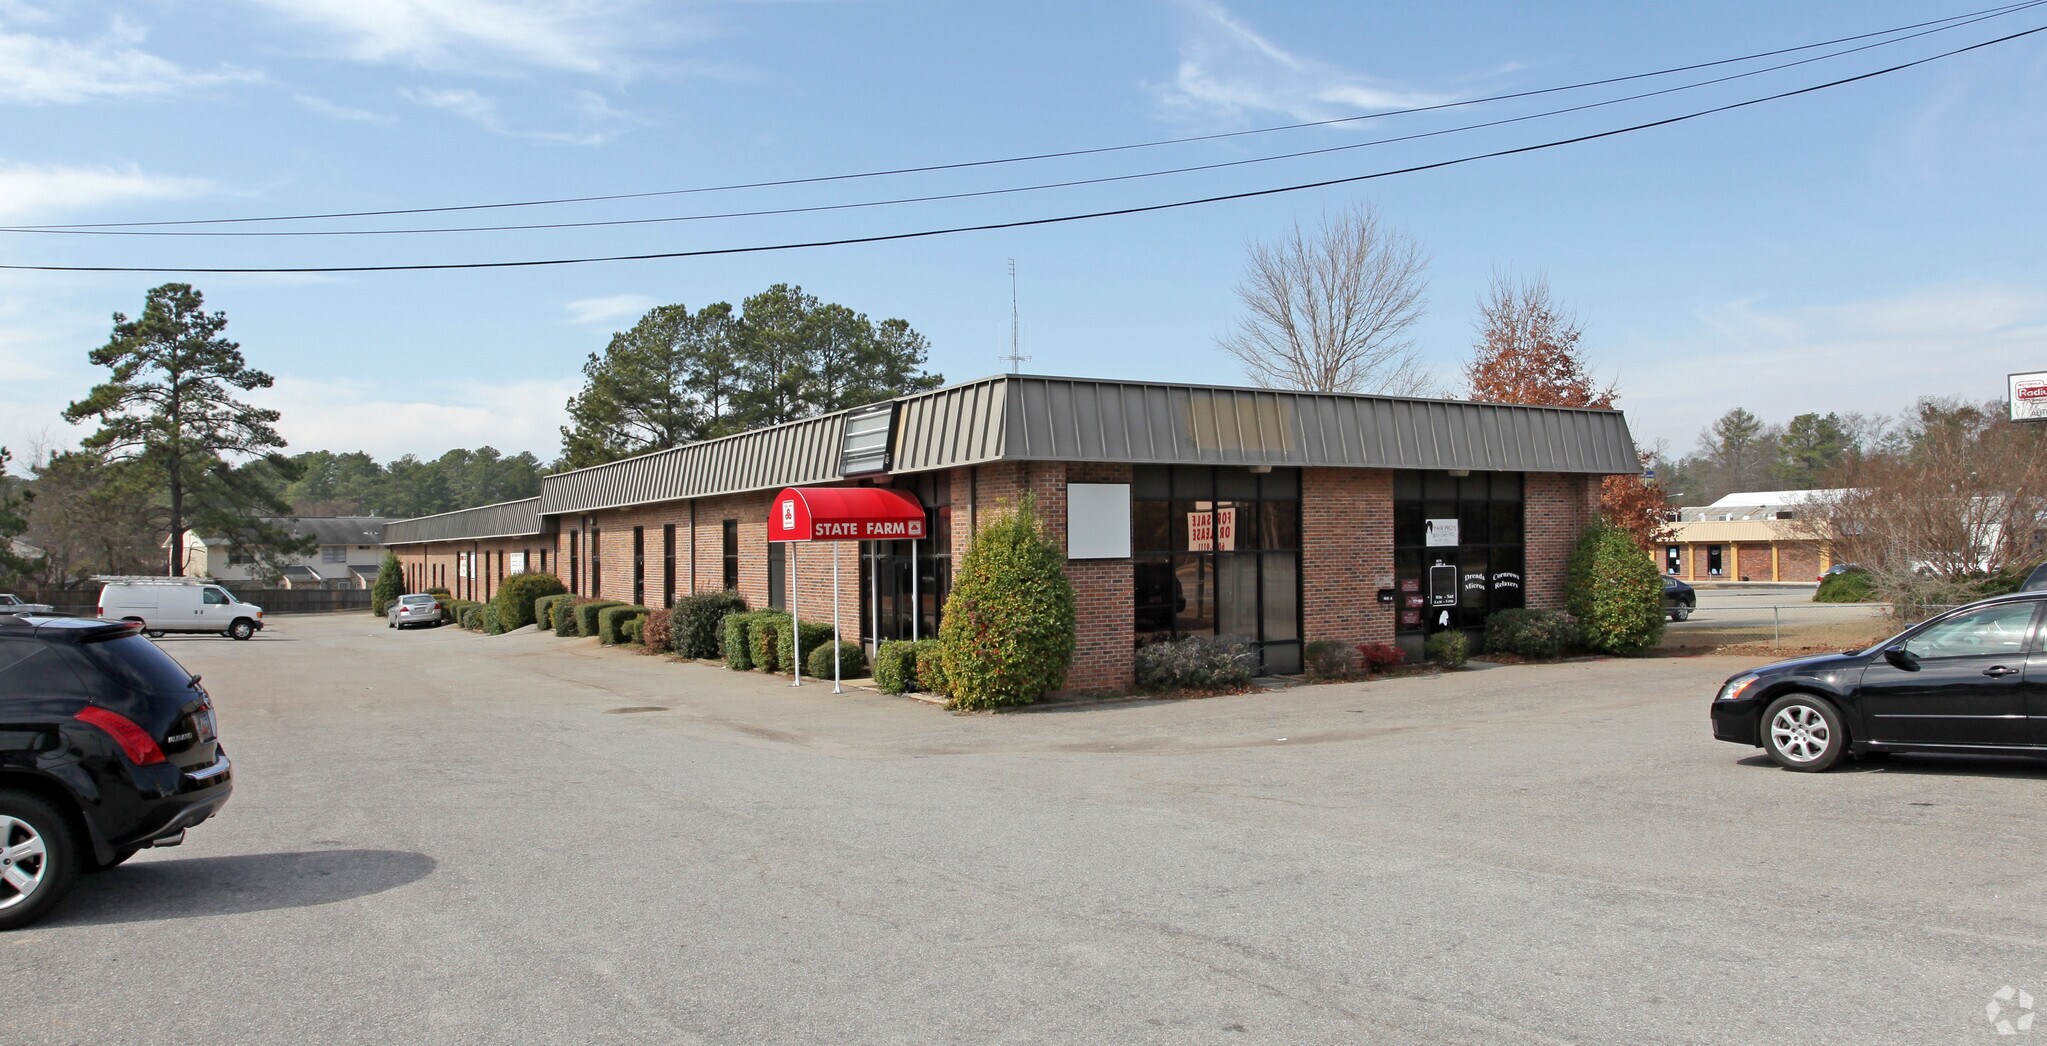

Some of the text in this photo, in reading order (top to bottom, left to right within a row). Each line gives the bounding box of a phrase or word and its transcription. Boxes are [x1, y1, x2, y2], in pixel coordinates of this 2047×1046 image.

[815, 522, 905, 536] STATE FARM
[1465, 573, 1485, 581] Dreads
[1493, 572, 1519, 580] Cornrows
[1465, 583, 1485, 591] Micros
[1495, 581, 1518, 589] Relaxers
